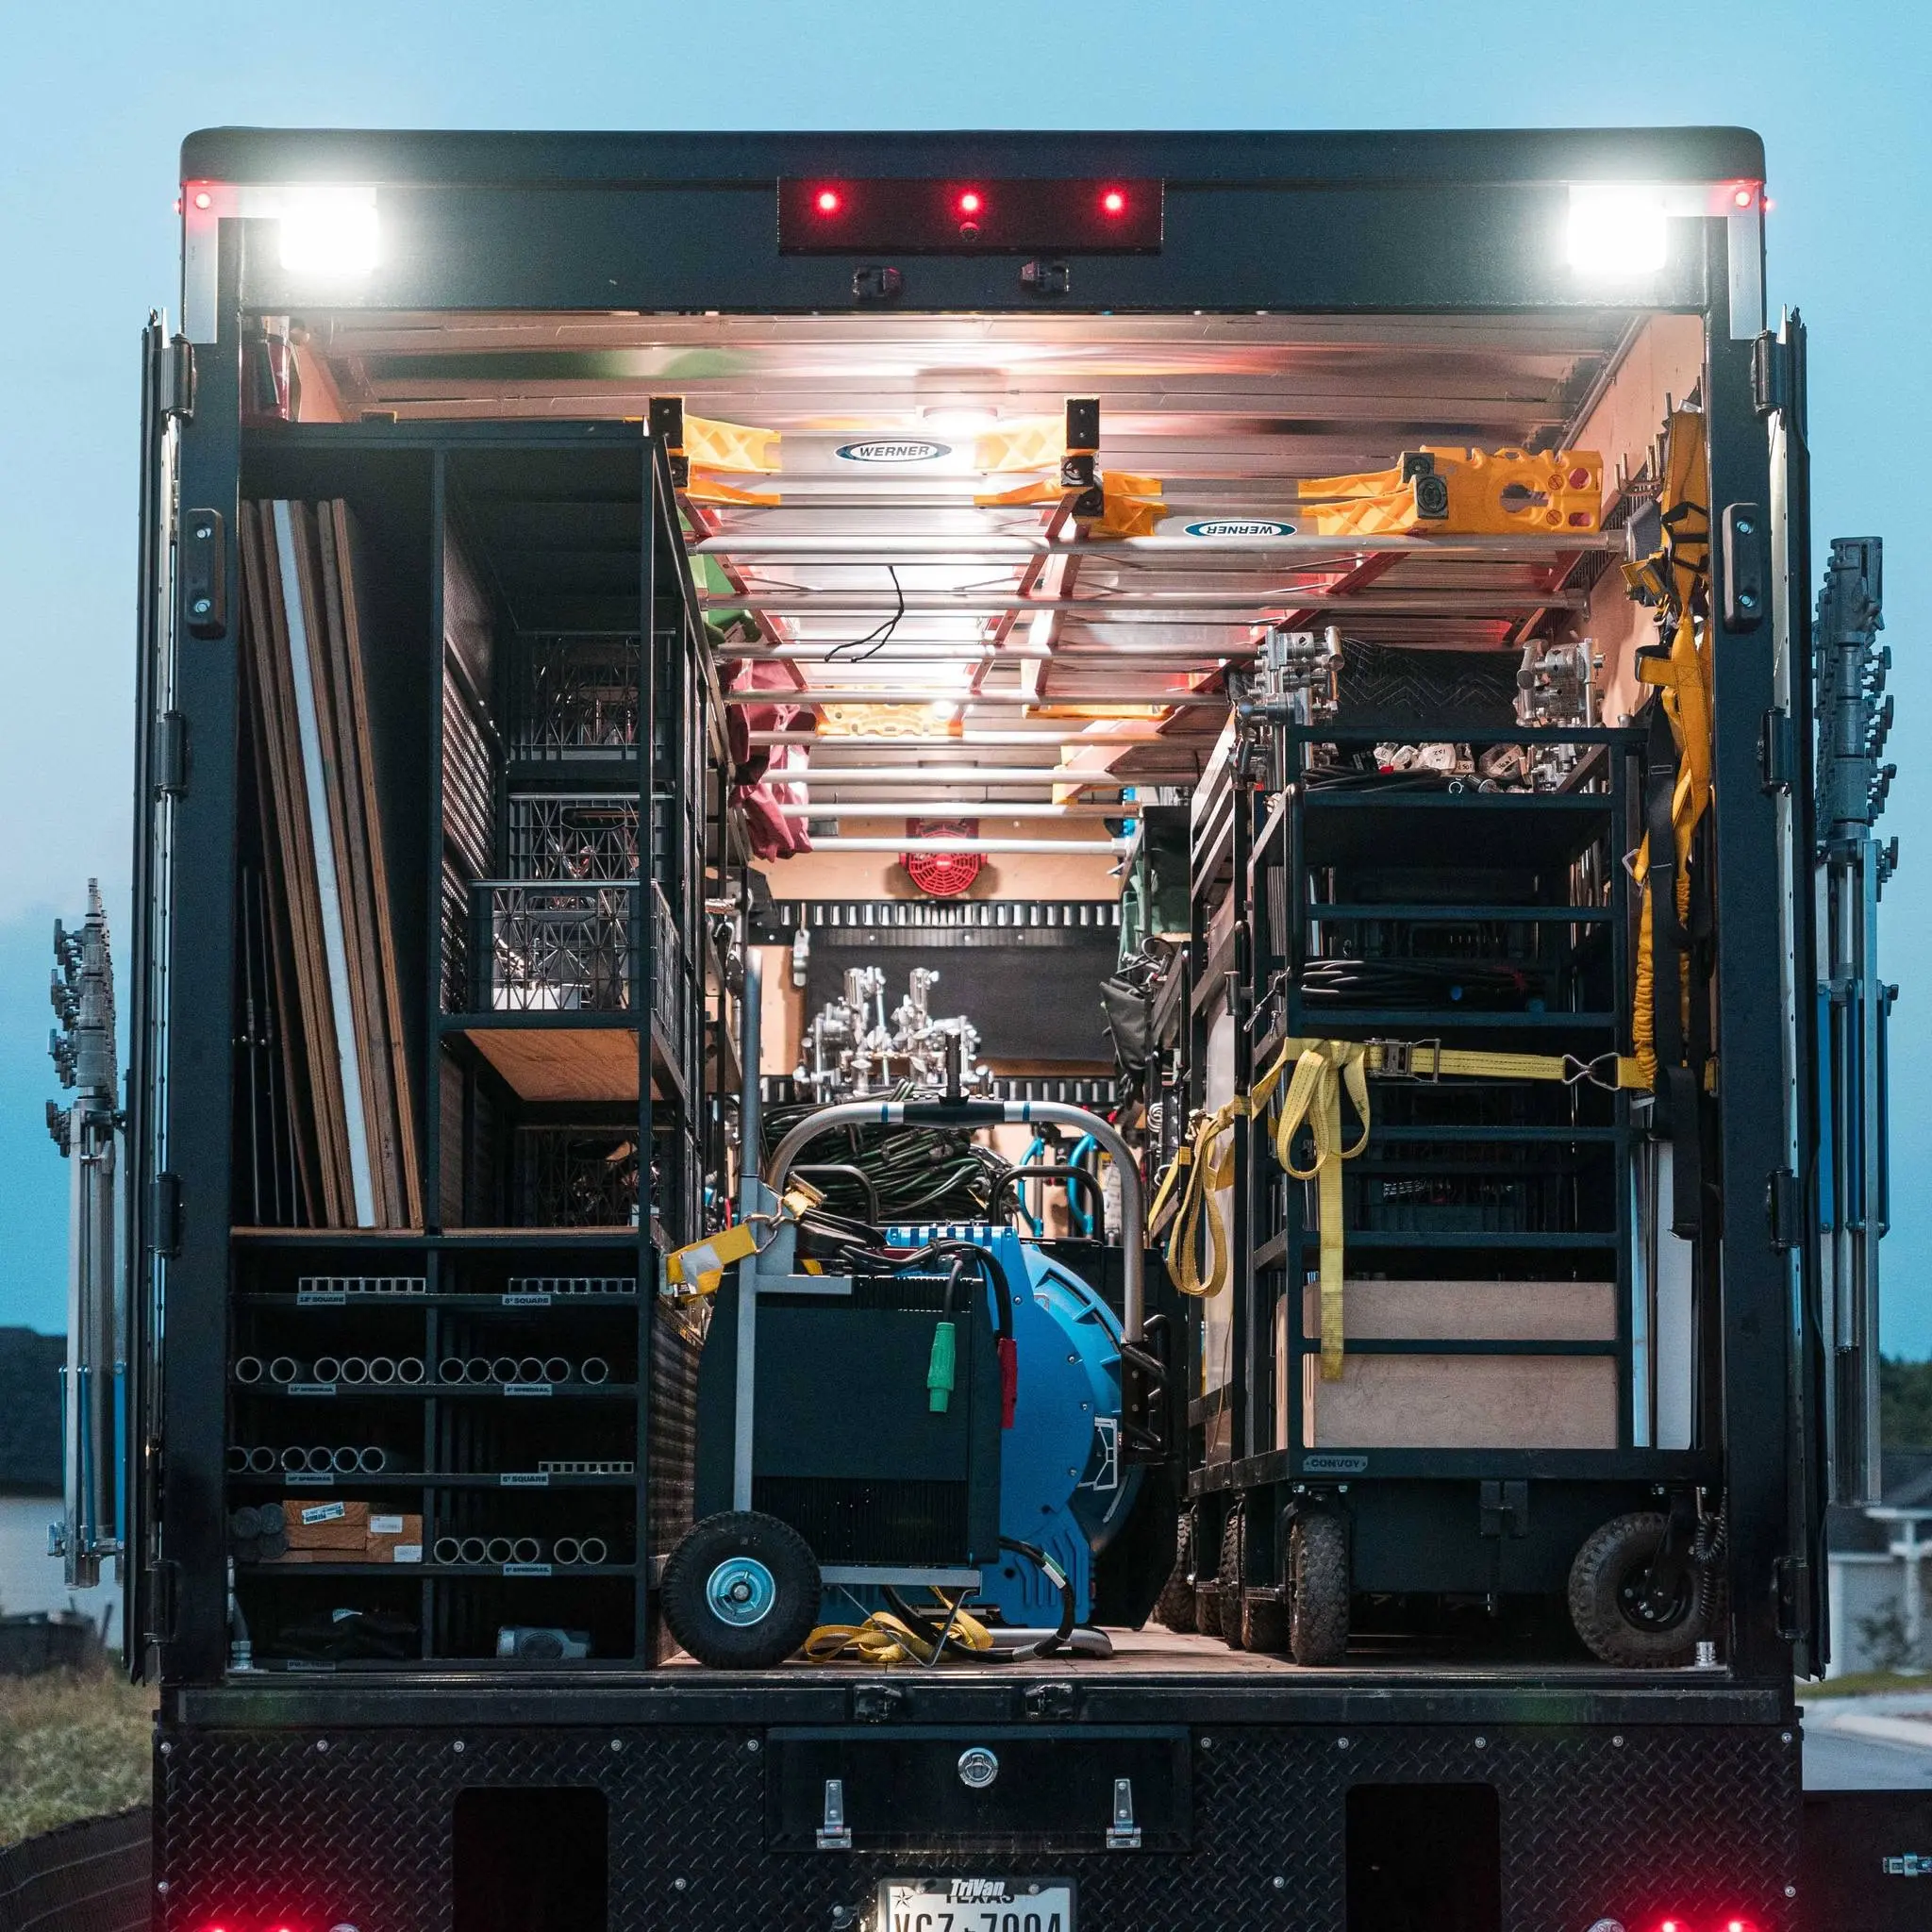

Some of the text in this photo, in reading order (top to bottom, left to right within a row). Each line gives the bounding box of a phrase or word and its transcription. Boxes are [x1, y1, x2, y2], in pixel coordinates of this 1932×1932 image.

[859, 446, 930, 458] WERNER
[1207, 525, 1274, 535] WERNER
[1310, 1458, 1359, 1468] CONVOY
[950, 1878, 1006, 1897] TriVan
